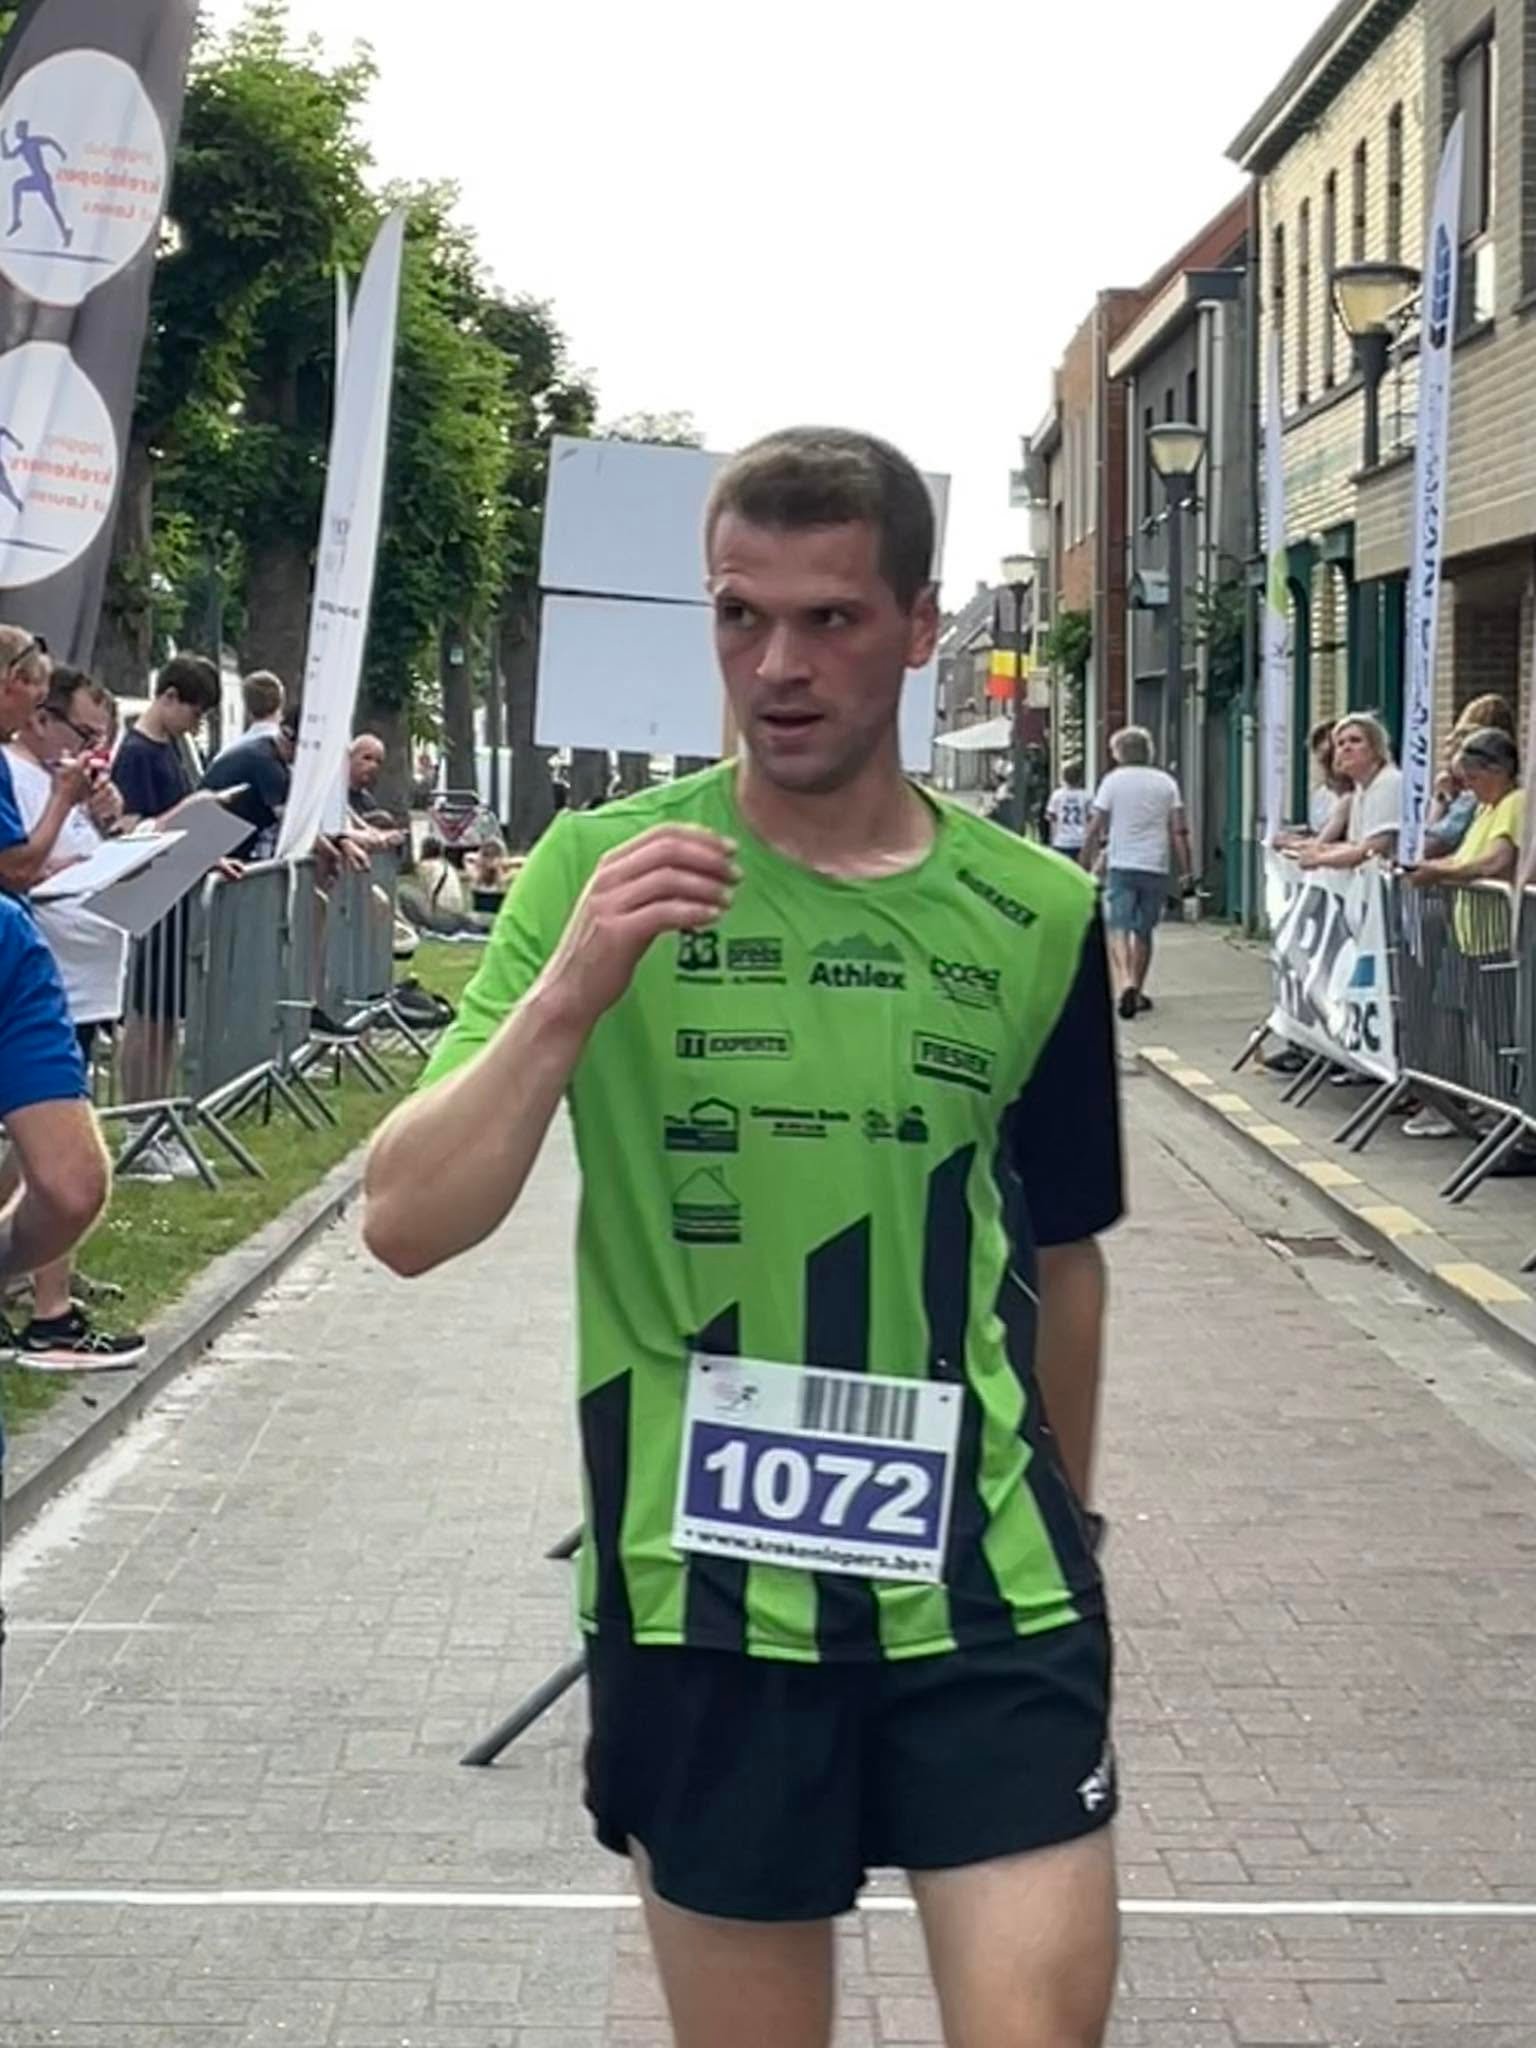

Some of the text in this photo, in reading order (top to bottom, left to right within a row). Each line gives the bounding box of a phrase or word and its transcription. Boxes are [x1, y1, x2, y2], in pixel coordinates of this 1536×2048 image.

[808, 961, 907, 992] Athlex
[704, 1439, 932, 1536] 1072
[697, 1530, 921, 1571] www.krekenlopers.be
